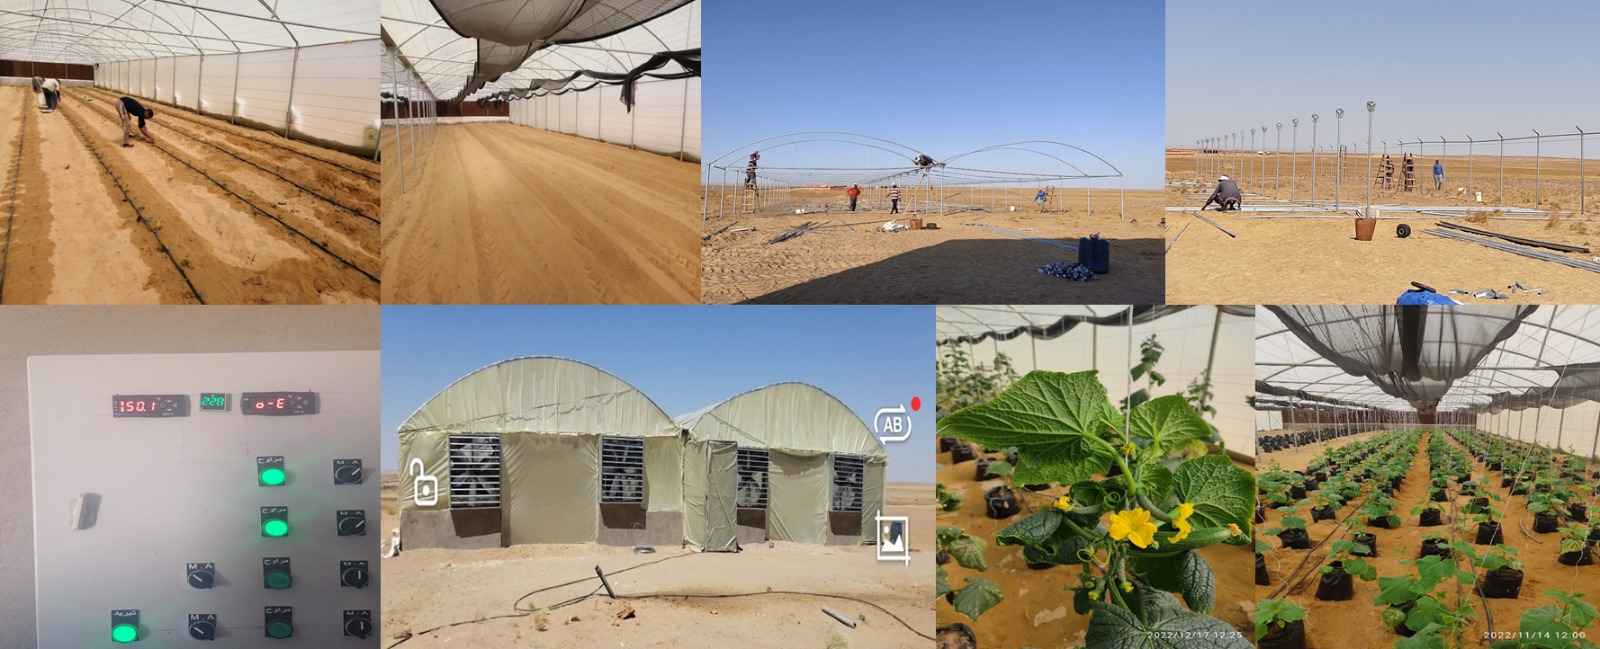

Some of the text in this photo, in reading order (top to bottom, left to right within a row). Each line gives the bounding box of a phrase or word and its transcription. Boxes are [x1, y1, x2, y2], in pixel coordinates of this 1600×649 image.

[201, 396, 225, 406] 228
[264, 558, 289, 566] مراوح
[113, 609, 137, 617] تبريد
